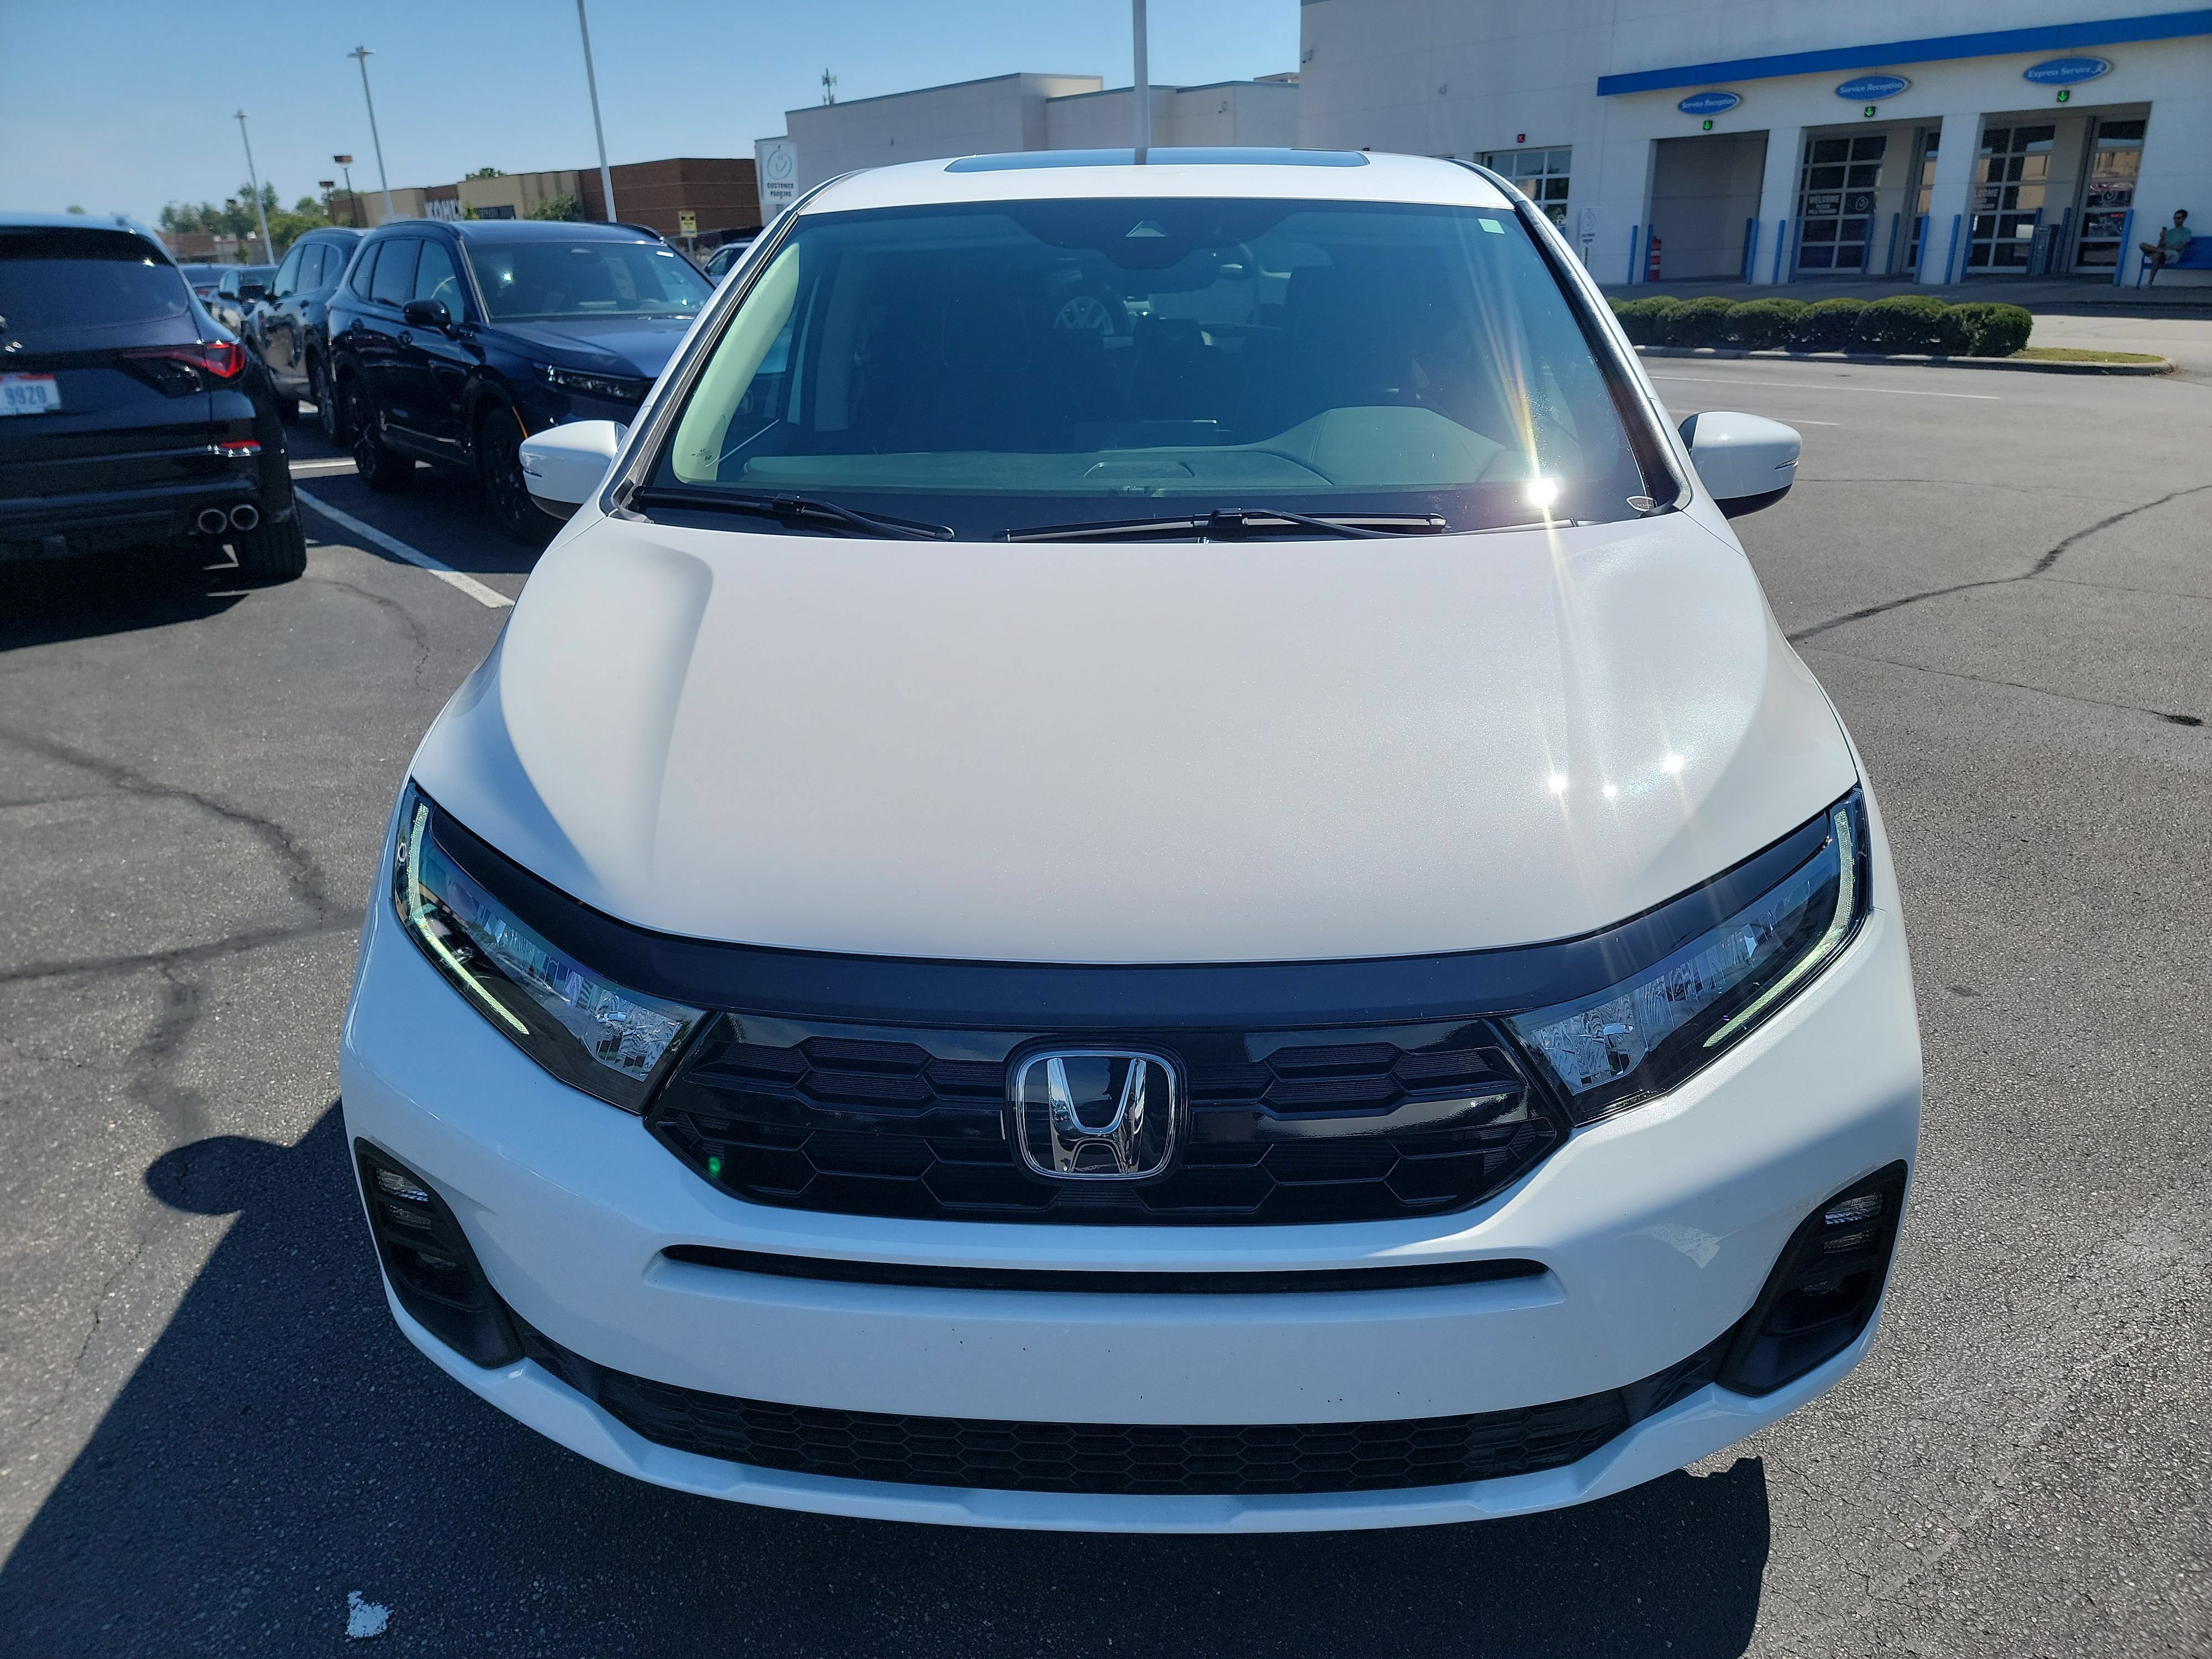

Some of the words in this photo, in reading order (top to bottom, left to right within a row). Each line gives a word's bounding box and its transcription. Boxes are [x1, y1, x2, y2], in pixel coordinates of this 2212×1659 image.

[2028, 70, 2058, 79] Express
[2061, 67, 2091, 75] Service
[1867, 82, 1903, 92] Reception
[1704, 98, 1736, 107] Reception
